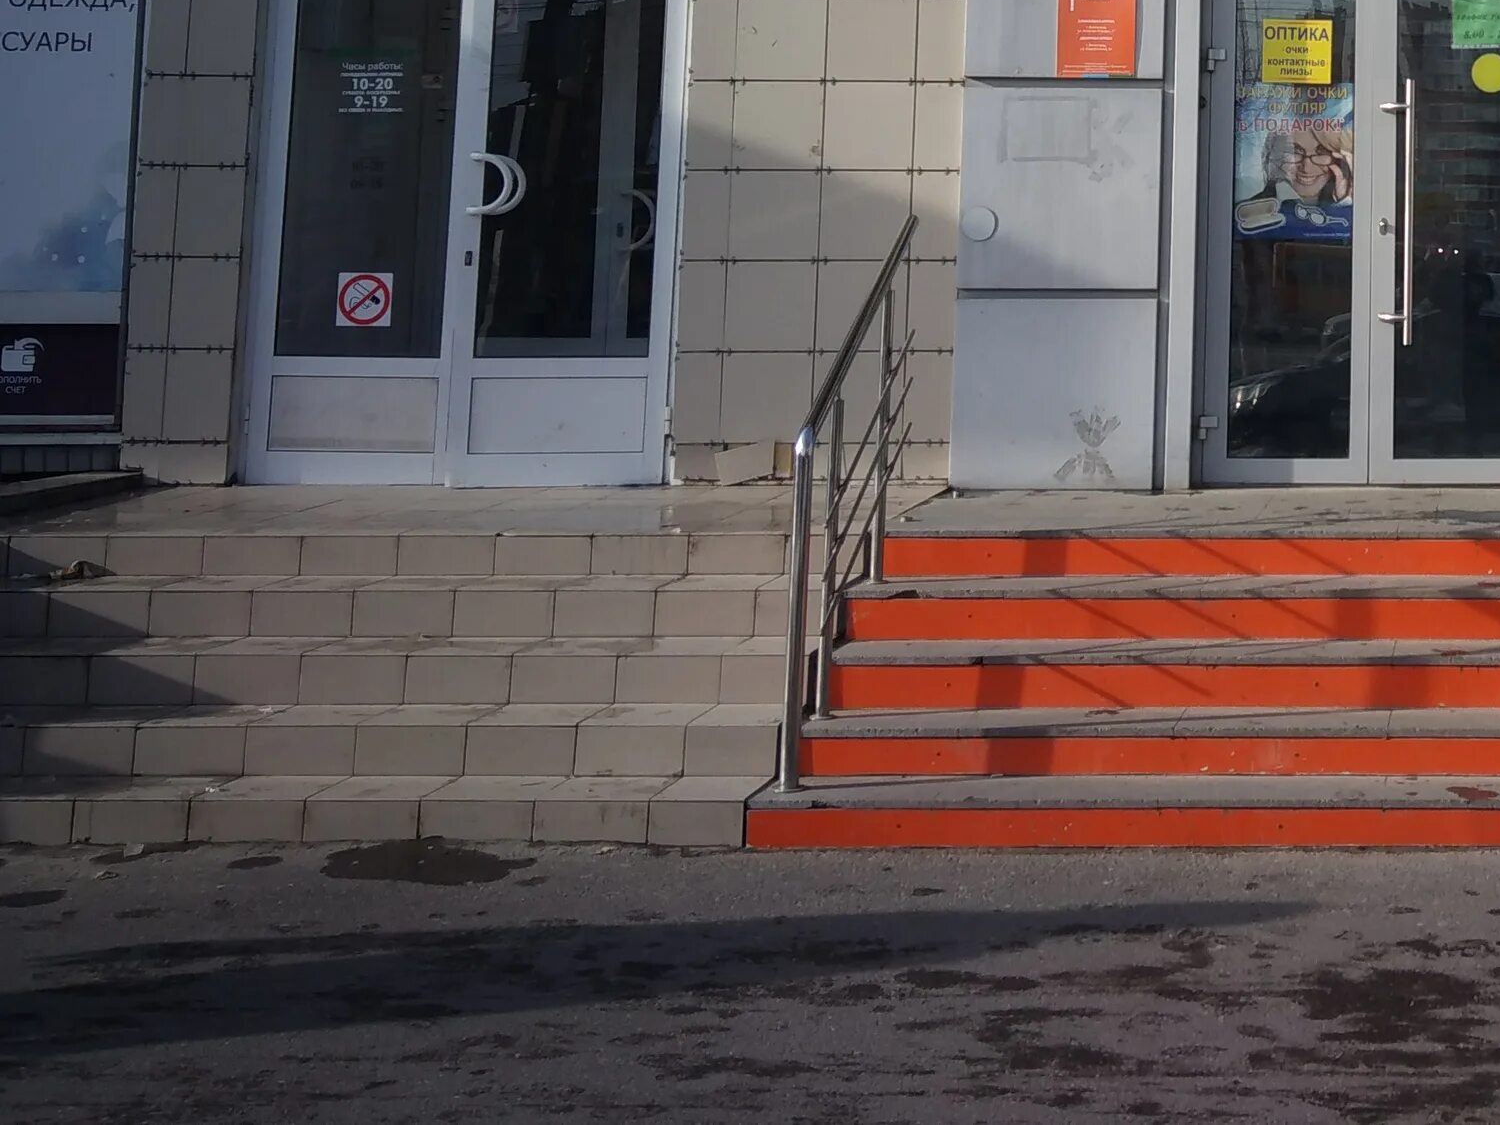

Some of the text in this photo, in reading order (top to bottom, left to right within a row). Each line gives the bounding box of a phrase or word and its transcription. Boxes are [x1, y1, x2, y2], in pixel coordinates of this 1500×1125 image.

[1264, 26, 1330, 41] ОПТИКА
[1, 31, 93, 52] СУАРЫ
[352, 78, 393, 90] 10-20
[1307, 87, 1348, 100] ОЧКИ
[354, 96, 388, 107] 9-19
[1268, 103, 1327, 114] ФУТЛЯР
